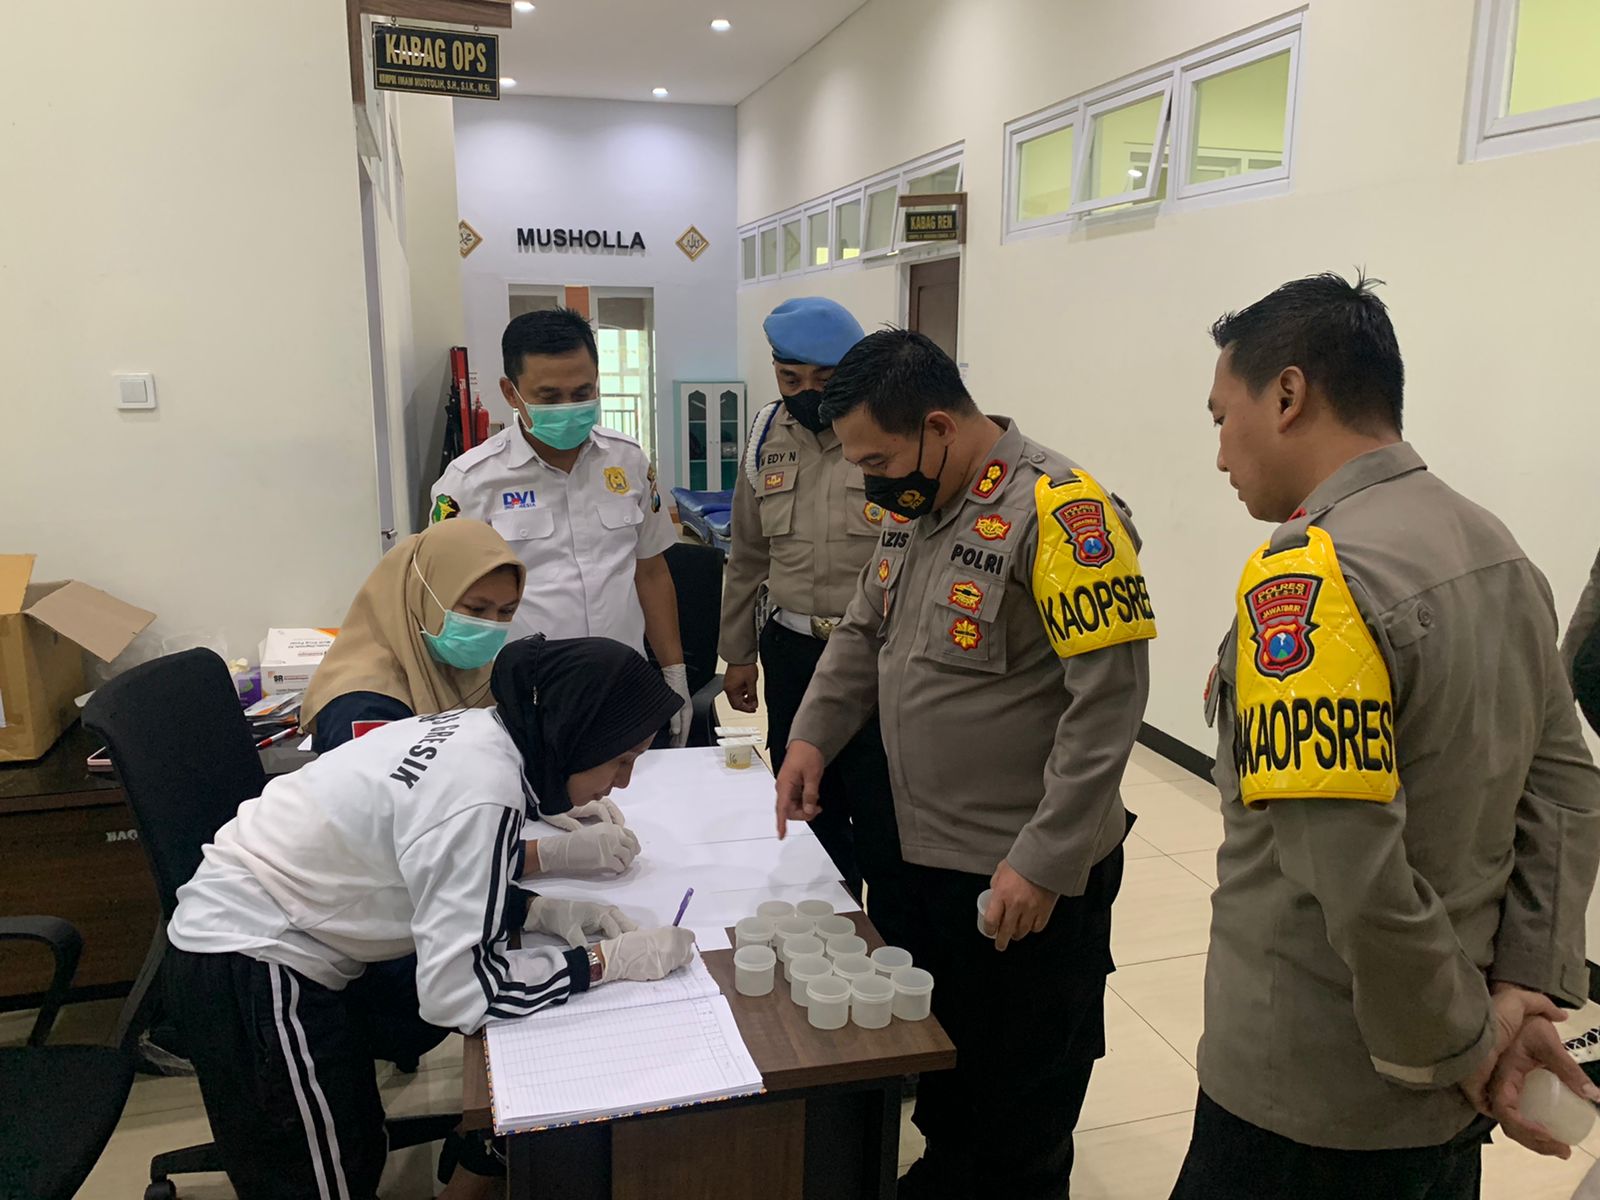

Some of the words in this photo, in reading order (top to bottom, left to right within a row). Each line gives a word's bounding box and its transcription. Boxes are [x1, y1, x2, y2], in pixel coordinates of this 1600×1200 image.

[385, 34, 447, 69] KABAG
[452, 40, 487, 73] OPS
[910, 215, 936, 230] KABAG
[516, 228, 646, 250] MUSHOLLA
[767, 452, 786, 464] EDY
[789, 451, 796, 462] N
[502, 490, 536, 506] DVI
[950, 543, 1004, 575] POLRI
[1258, 582, 1305, 597] POLRES
[1040, 575, 1155, 643] KAOPSRE
[389, 724, 460, 789] GRESIK
